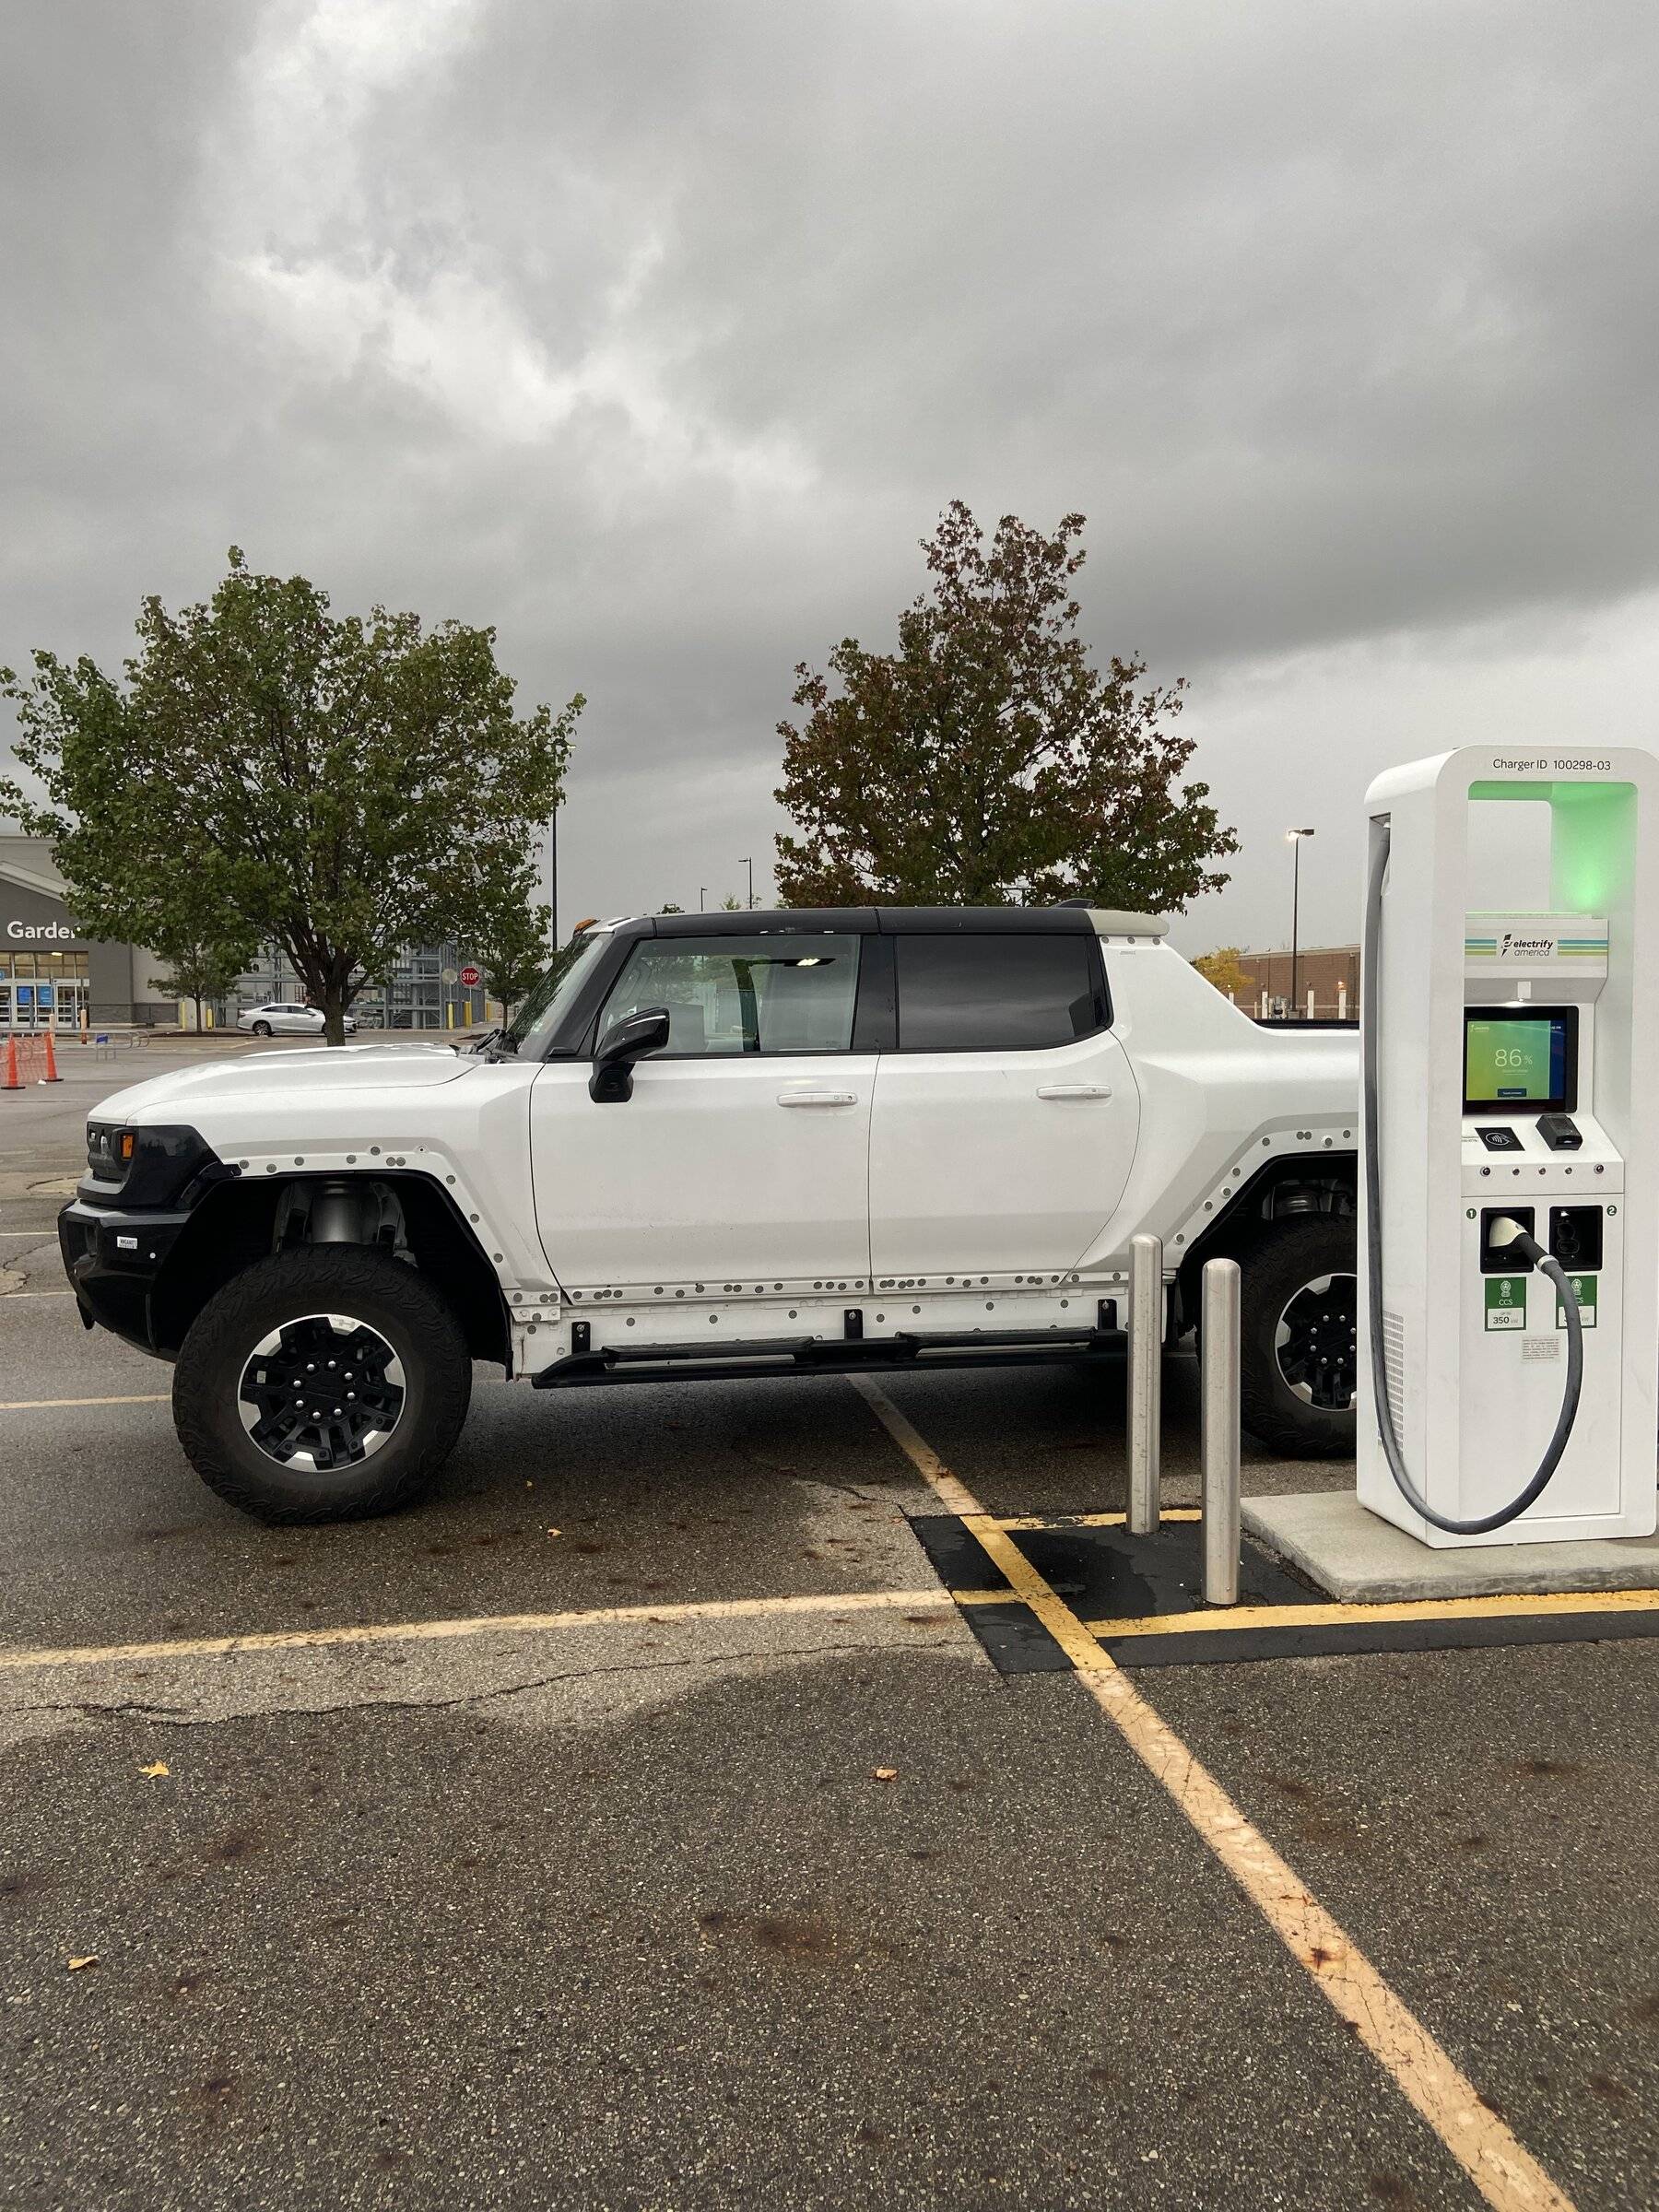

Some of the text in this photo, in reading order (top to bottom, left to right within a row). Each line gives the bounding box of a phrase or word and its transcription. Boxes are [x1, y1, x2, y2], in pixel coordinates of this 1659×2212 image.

[1492, 759, 1611, 771] Charger ID 100298-03
[1513, 940, 1554, 949] electrify
[462, 972, 478, 981] STOP
[1492, 1316, 1510, 1324] 350
